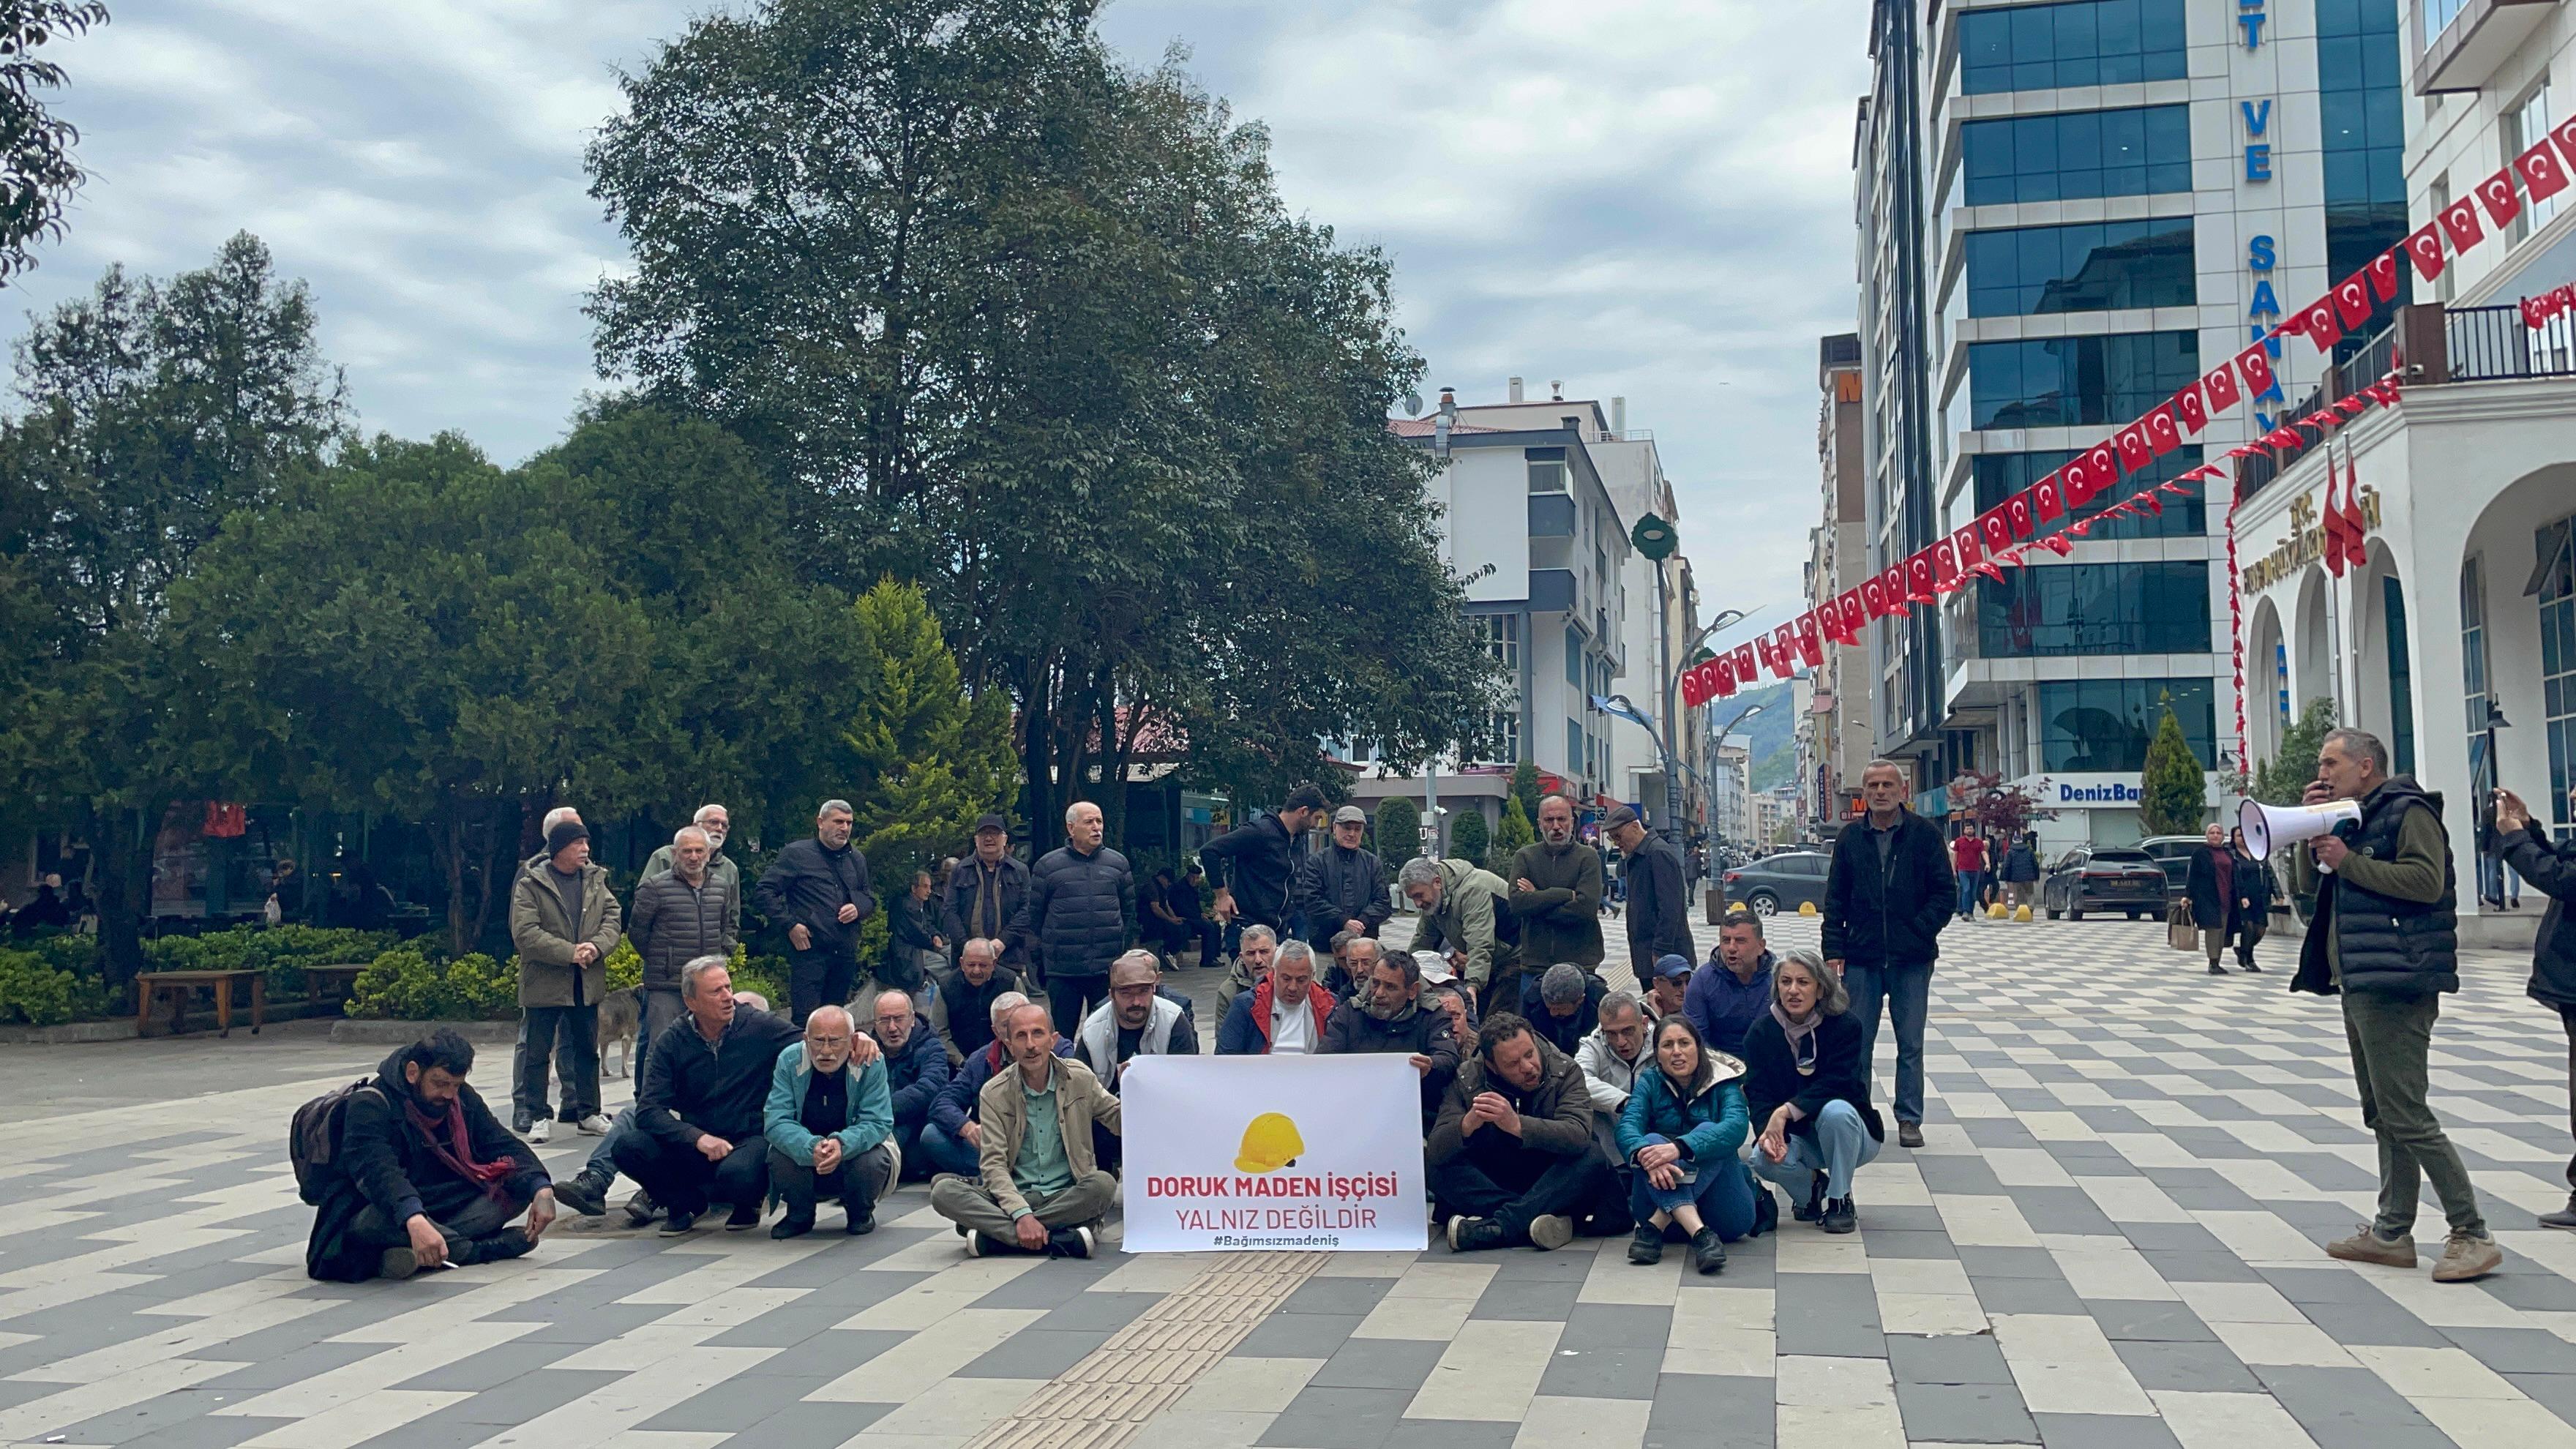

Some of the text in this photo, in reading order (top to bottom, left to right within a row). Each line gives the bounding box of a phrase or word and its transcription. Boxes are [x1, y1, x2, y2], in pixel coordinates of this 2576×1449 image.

[2239, 0, 2266, 48] T
[2241, 100, 2272, 181] VE
[1147, 1172, 1398, 1202] DORUK MADEN İŞÇİSİ
[1175, 1204, 1377, 1230] YALNIZ DEĞİLDİR
[1213, 1235, 1340, 1247] #Bağımsızmadeniş
